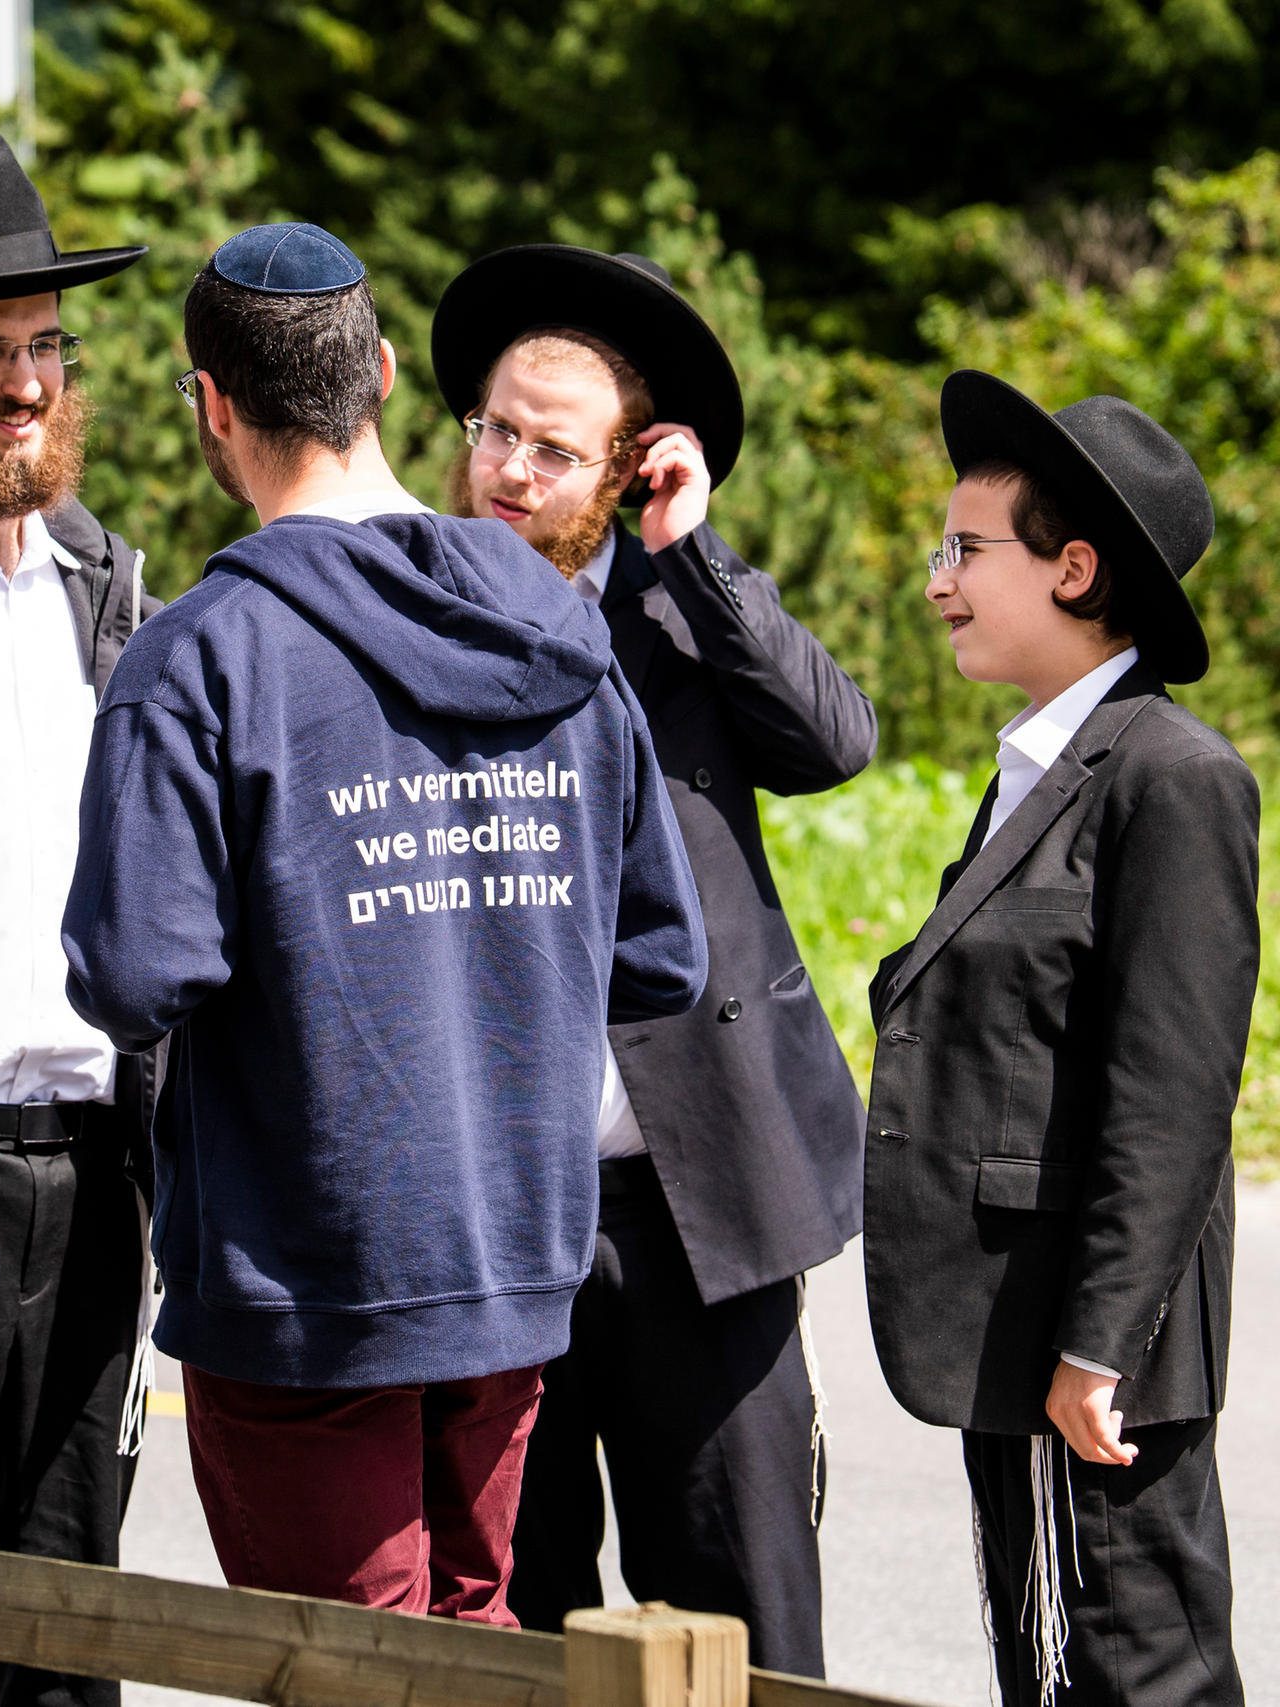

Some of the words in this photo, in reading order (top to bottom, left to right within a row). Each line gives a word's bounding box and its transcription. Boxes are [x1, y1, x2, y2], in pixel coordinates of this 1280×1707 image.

[327, 773, 391, 817] wir
[398, 760, 581, 803] vermitteln
[354, 831, 418, 866] we
[426, 815, 561, 857] mediate
[482, 874, 574, 907] אנחנו
